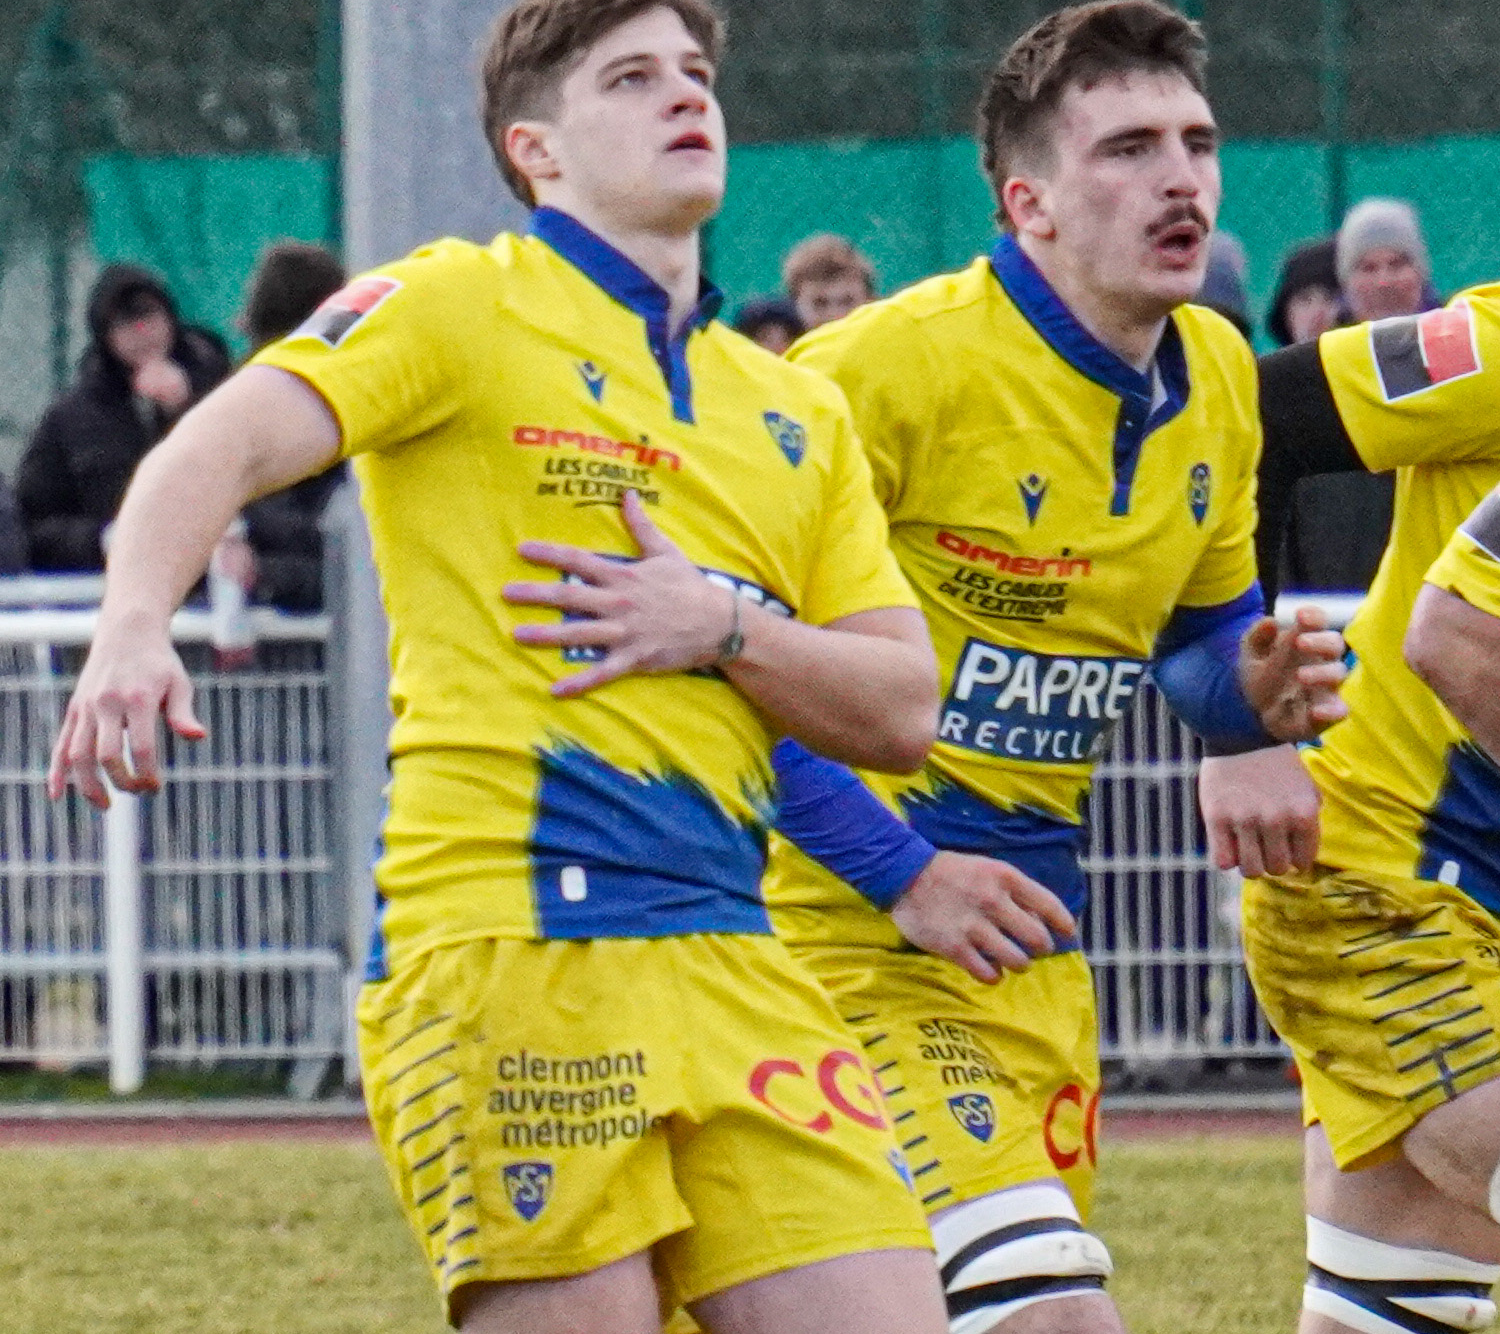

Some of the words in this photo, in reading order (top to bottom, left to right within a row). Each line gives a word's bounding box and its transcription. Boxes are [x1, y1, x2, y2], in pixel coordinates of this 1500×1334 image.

[513, 425, 682, 471] amerin
[544, 457, 582, 476] LES
[937, 531, 1092, 578] amerin
[954, 642, 1143, 720] PAPRE
[498, 1048, 648, 1084] clermont
[487, 1082, 637, 1116] auvergne
[749, 1049, 888, 1133] CG
